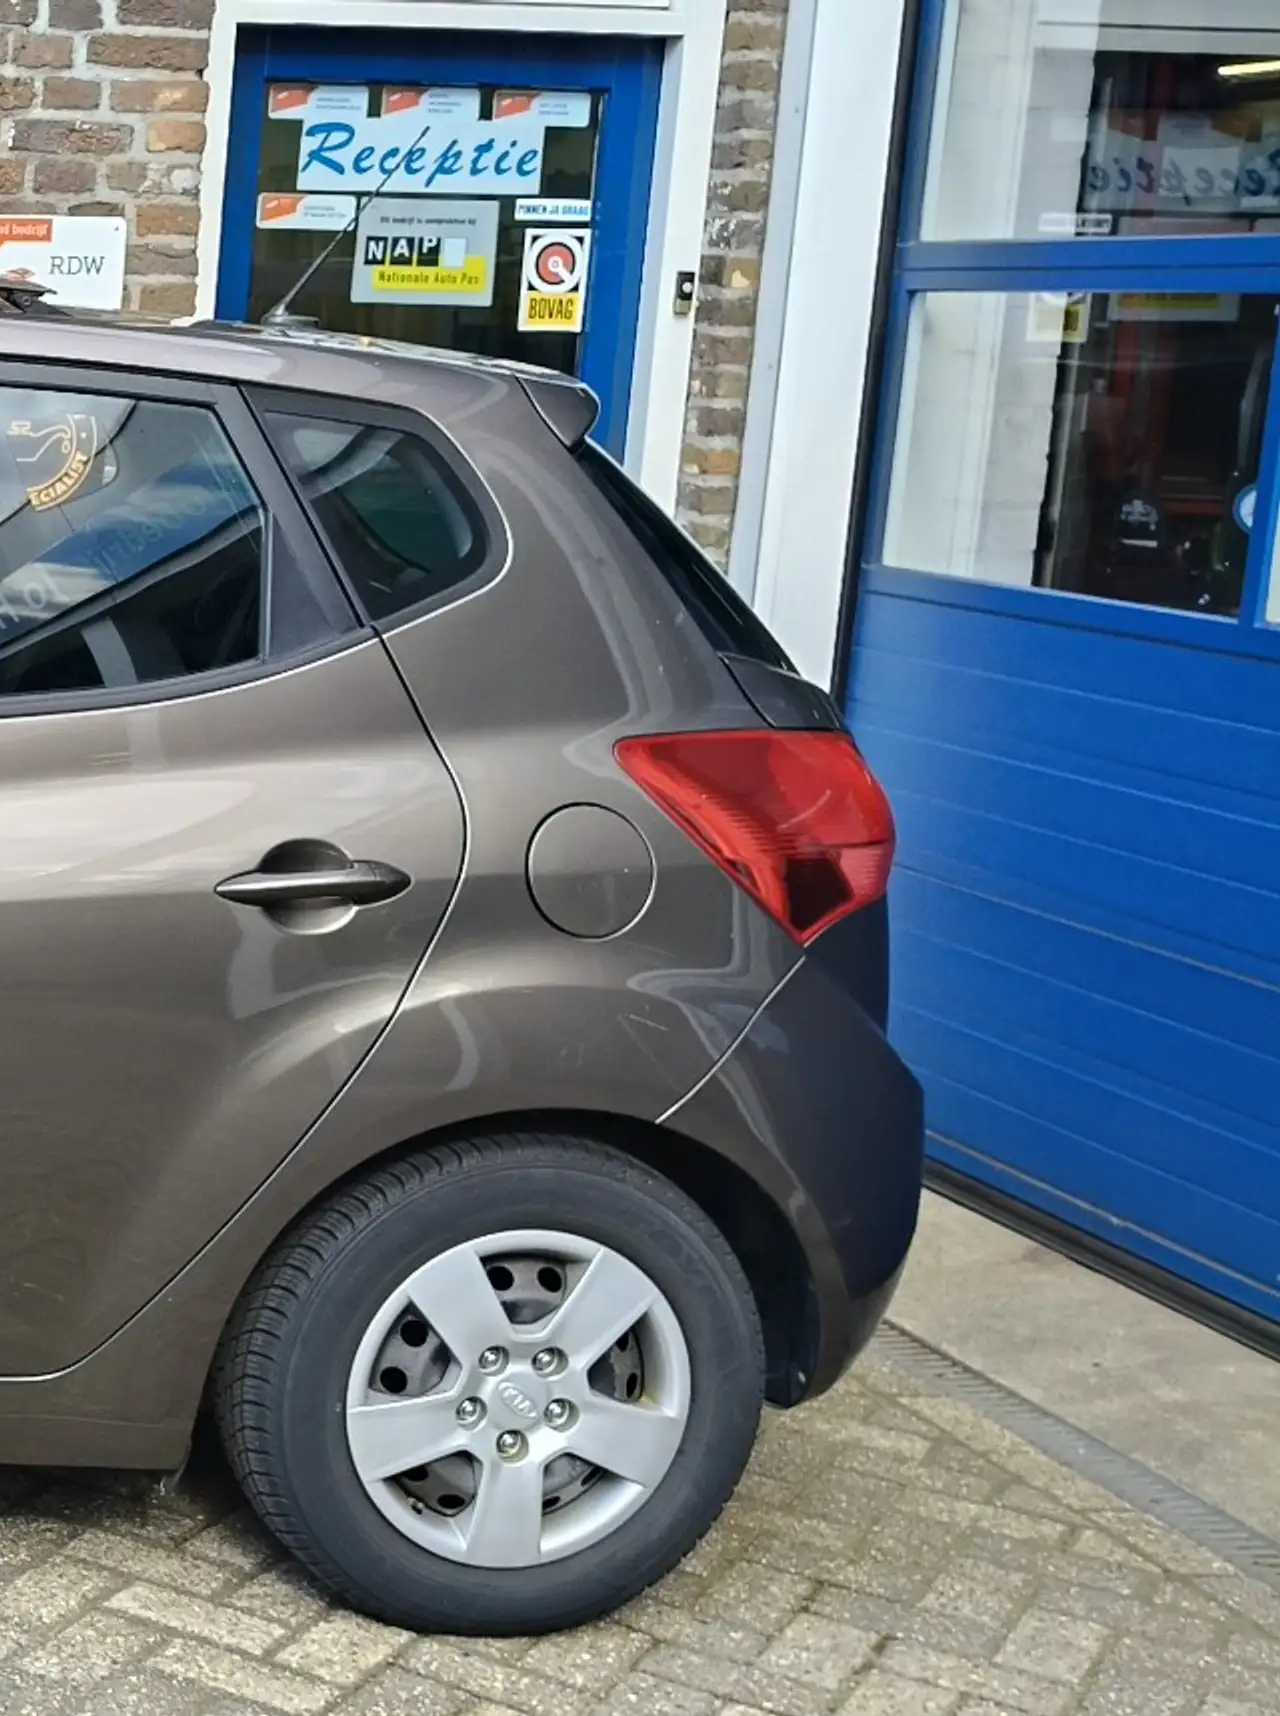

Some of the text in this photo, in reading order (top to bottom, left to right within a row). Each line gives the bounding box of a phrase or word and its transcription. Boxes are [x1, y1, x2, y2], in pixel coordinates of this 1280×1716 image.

[301, 121, 539, 188] Receptie
[366, 235, 438, 261] NAP
[48, 255, 106, 276] RDW
[378, 270, 429, 284] Nationale
[433, 273, 458, 285] Auto
[527, 297, 574, 320] BOVAG
